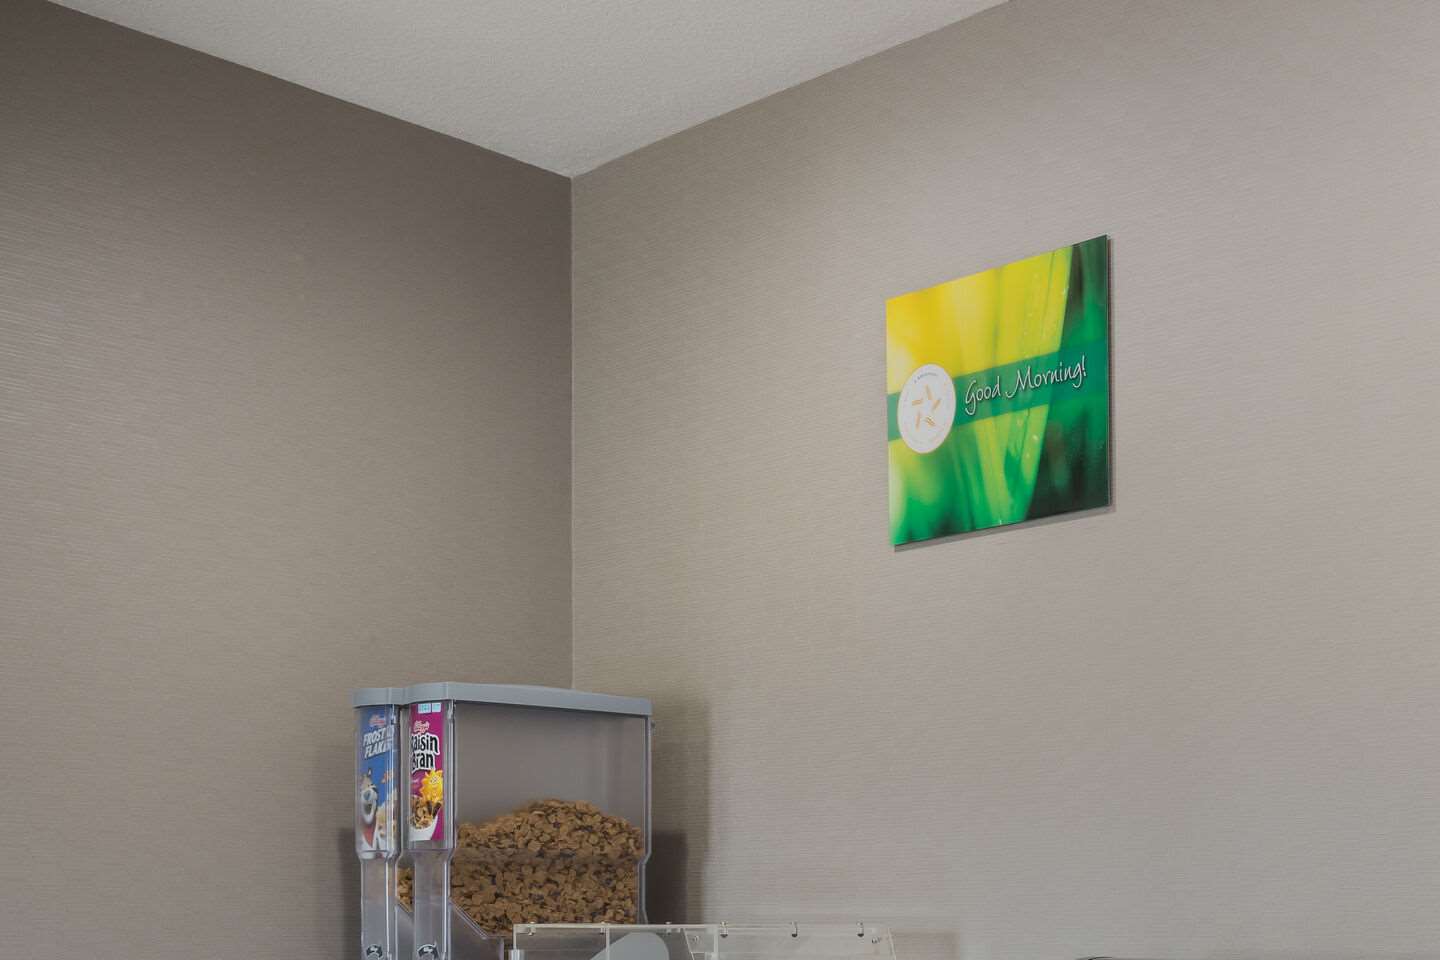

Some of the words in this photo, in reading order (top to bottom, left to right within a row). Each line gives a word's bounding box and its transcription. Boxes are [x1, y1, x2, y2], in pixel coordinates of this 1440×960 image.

[964, 375, 1001, 416] Good
[1005, 354, 1087, 398] Morning!
[363, 726, 395, 747] FROST
[411, 733, 440, 755] aisin
[411, 752, 435, 771] ran
